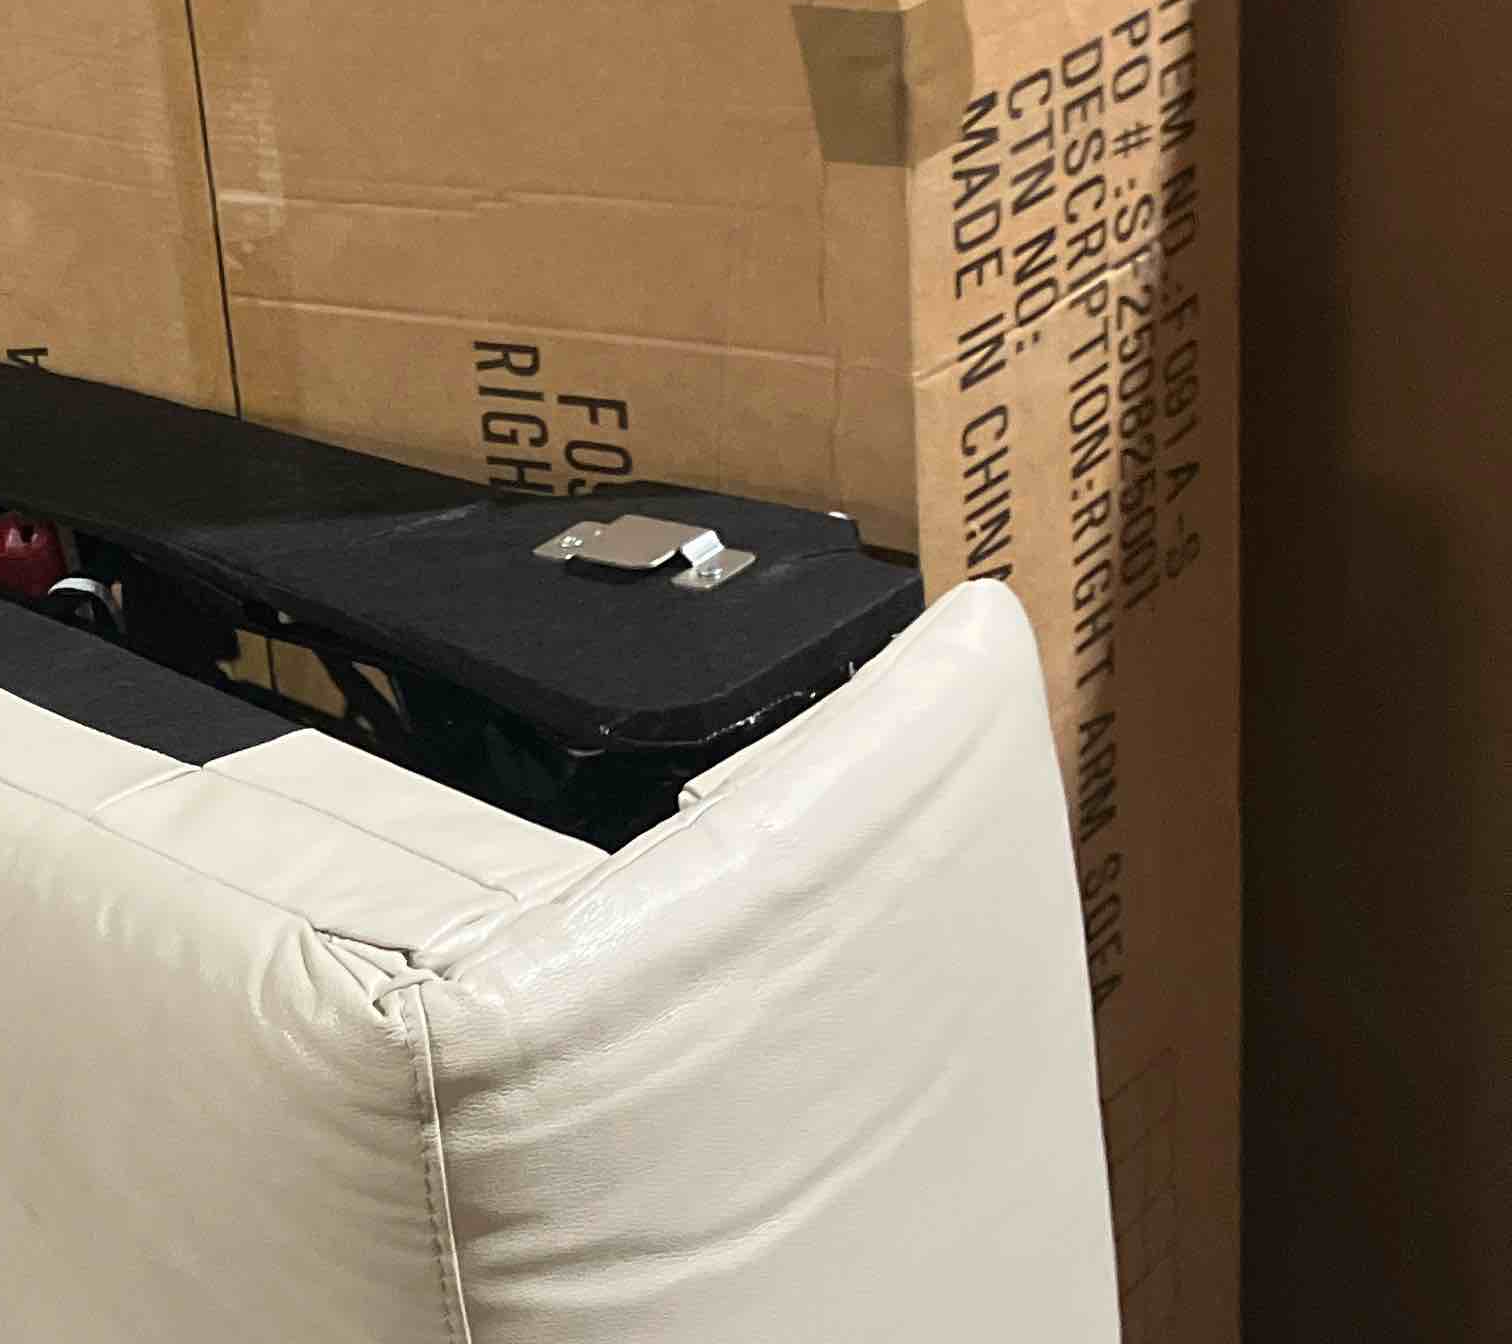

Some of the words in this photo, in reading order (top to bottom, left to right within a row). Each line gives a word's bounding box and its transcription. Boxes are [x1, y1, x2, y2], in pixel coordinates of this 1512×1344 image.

[1110, 8, 1152, 104] PO
[951, 89, 1004, 301] MADE
[1006, 66, 1056, 218] CTN
[956, 311, 1008, 393] IN
[1011, 225, 1059, 355] NO:
[1078, 710, 1118, 844] ARM
